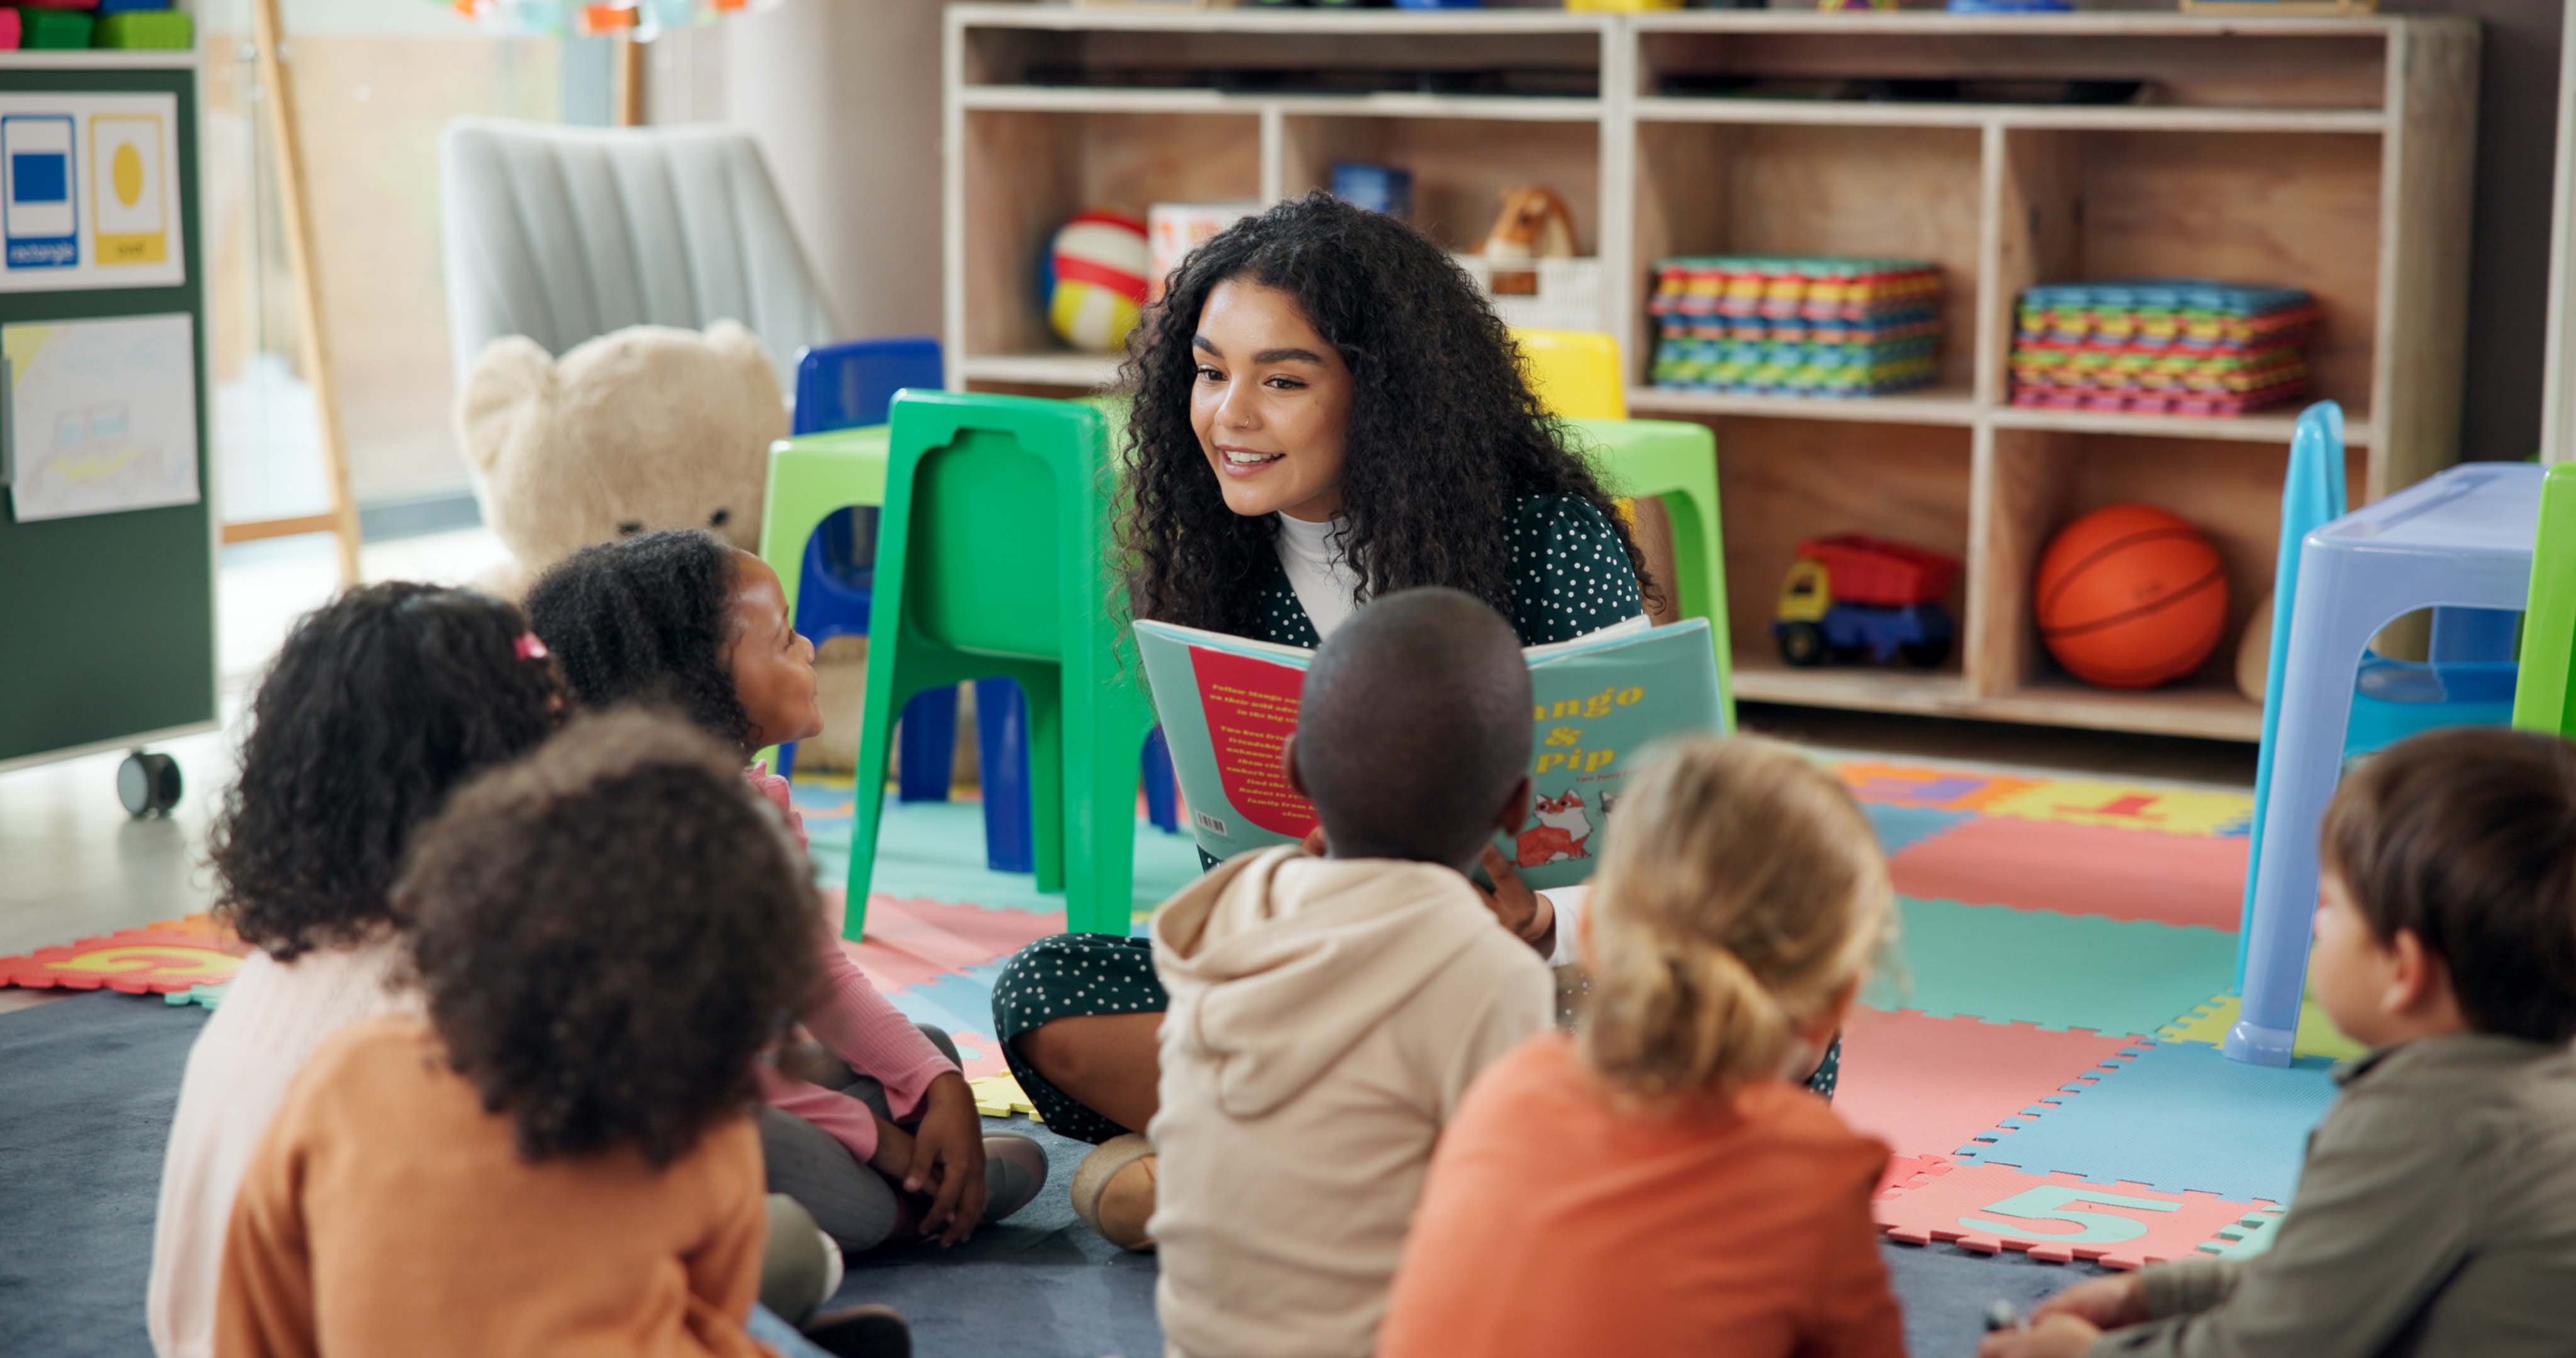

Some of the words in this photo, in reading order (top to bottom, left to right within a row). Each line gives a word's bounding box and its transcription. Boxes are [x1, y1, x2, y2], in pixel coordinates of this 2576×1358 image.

[1248, 690, 1282, 701] Mango
[1533, 687, 1644, 720] ngo
[1544, 726, 1583, 747] &
[1958, 1185, 2184, 1243] 5
